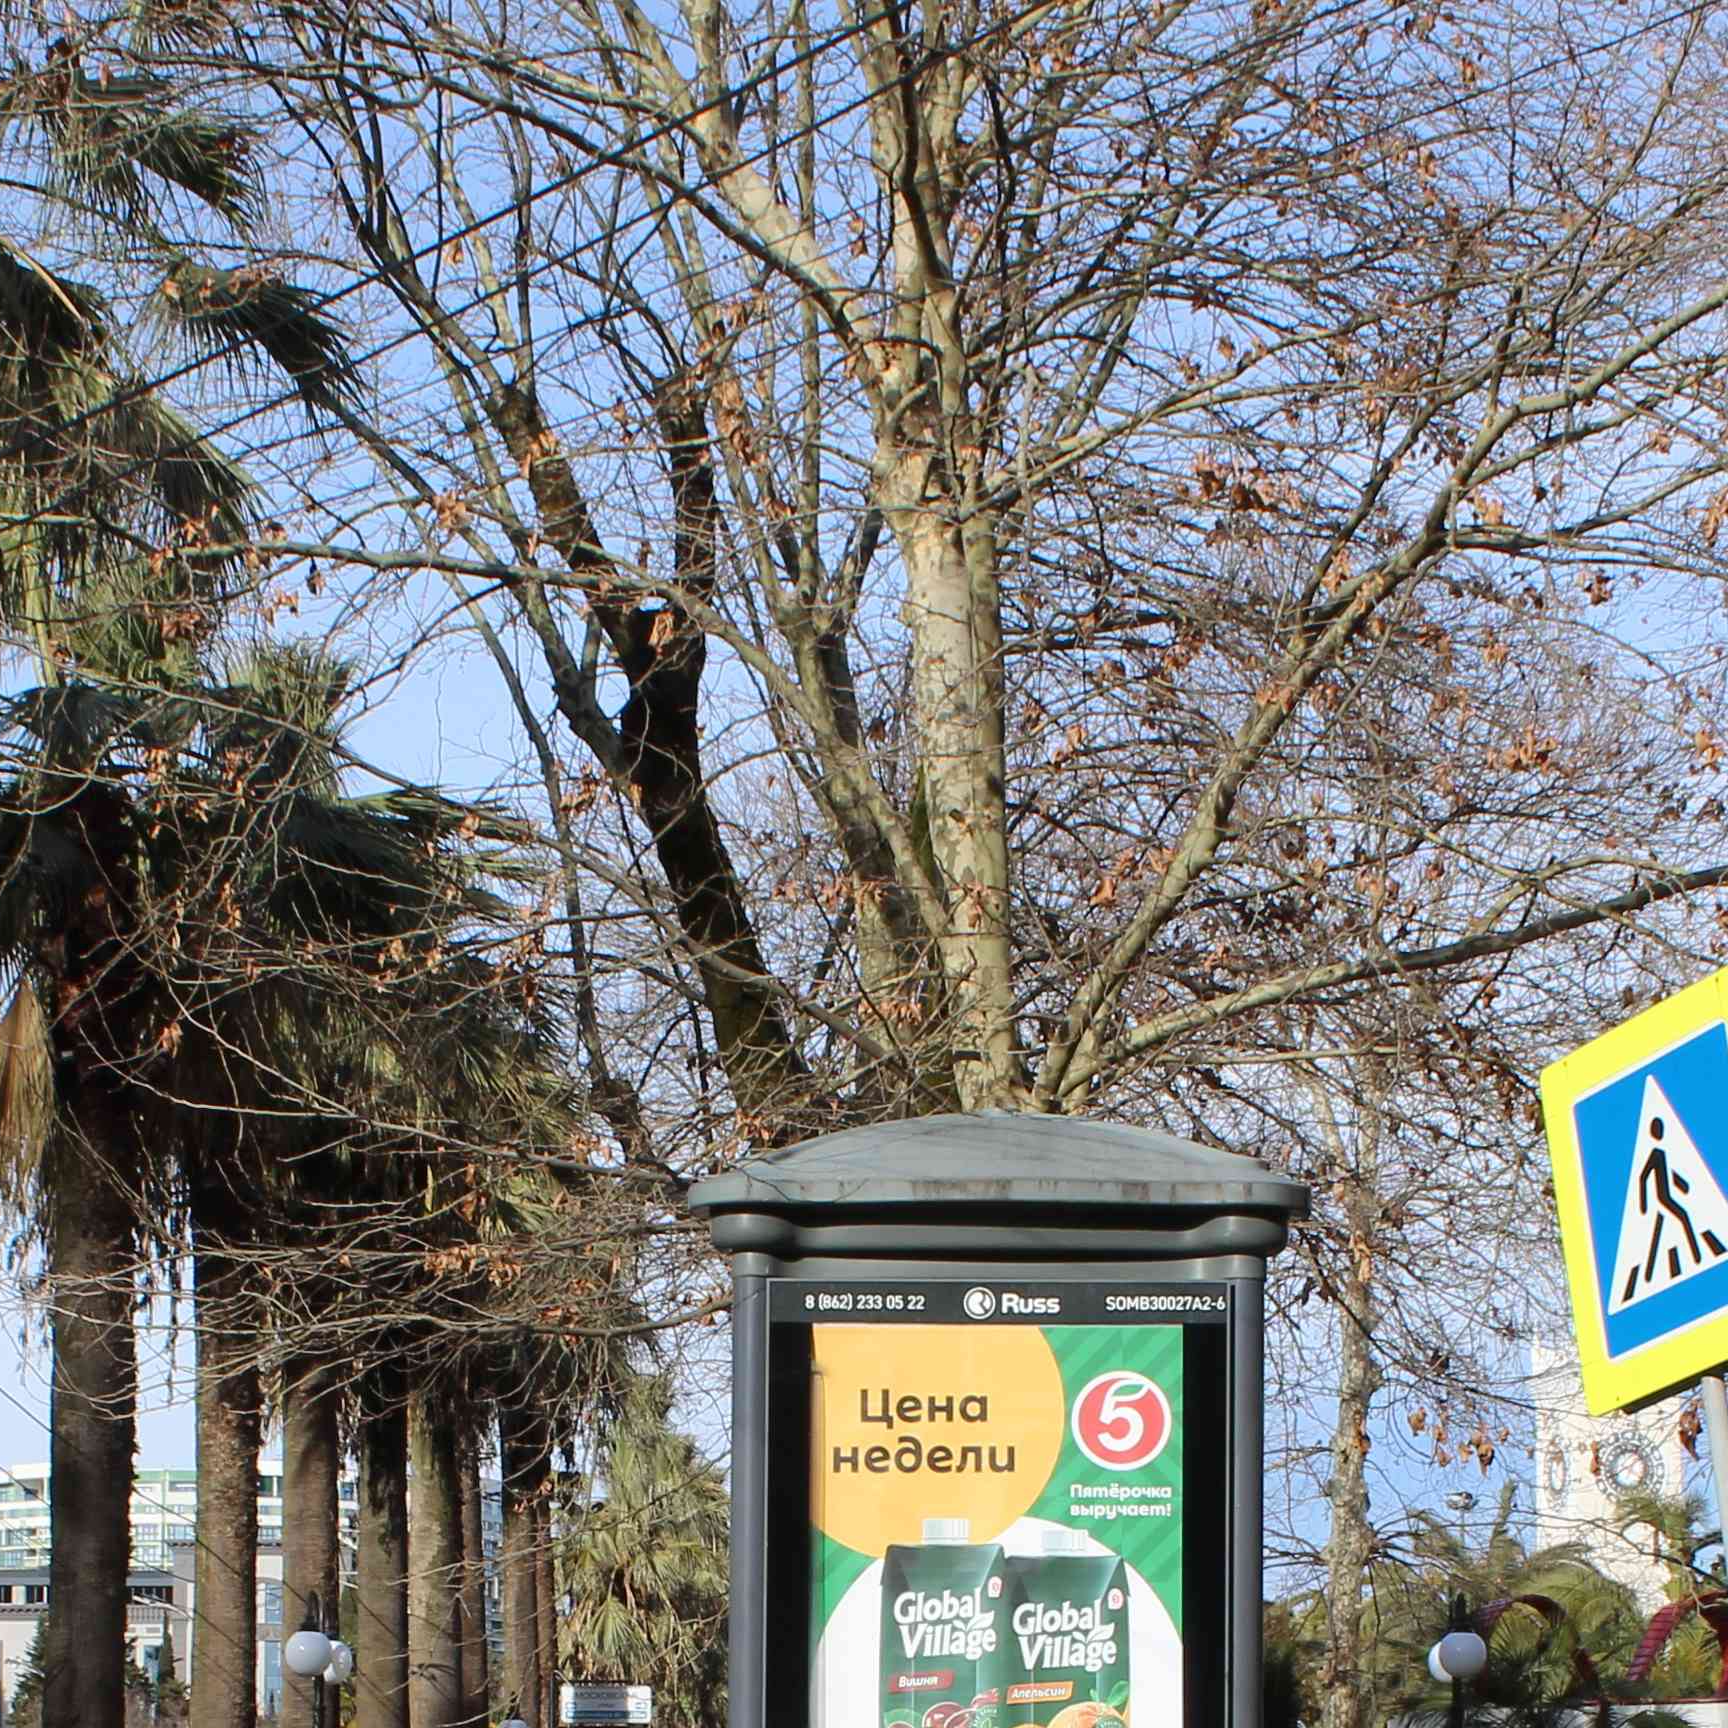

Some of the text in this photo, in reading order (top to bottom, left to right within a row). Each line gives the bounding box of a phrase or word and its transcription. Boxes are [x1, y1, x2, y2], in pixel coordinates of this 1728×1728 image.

[804, 1293, 925, 1312] 8 (862) 233 05 22
[1001, 1293, 1061, 1314] Russ
[1105, 1296, 1226, 1311] SOMB30027A2-6
[859, 1387, 989, 1430] Цена
[1097, 1379, 1150, 1452] 5
[832, 1437, 1016, 1474] недели
[1069, 1483, 1172, 1501] Пятёрочка
[1069, 1503, 1172, 1519] выручает!
[893, 1586, 995, 1625] Global
[1012, 1599, 1115, 1637] Global
[899, 1622, 997, 1660] Village
[1018, 1634, 1117, 1672] Village
[898, 1675, 939, 1688] Вишня
[1011, 1686, 1067, 1699] Апельсин
